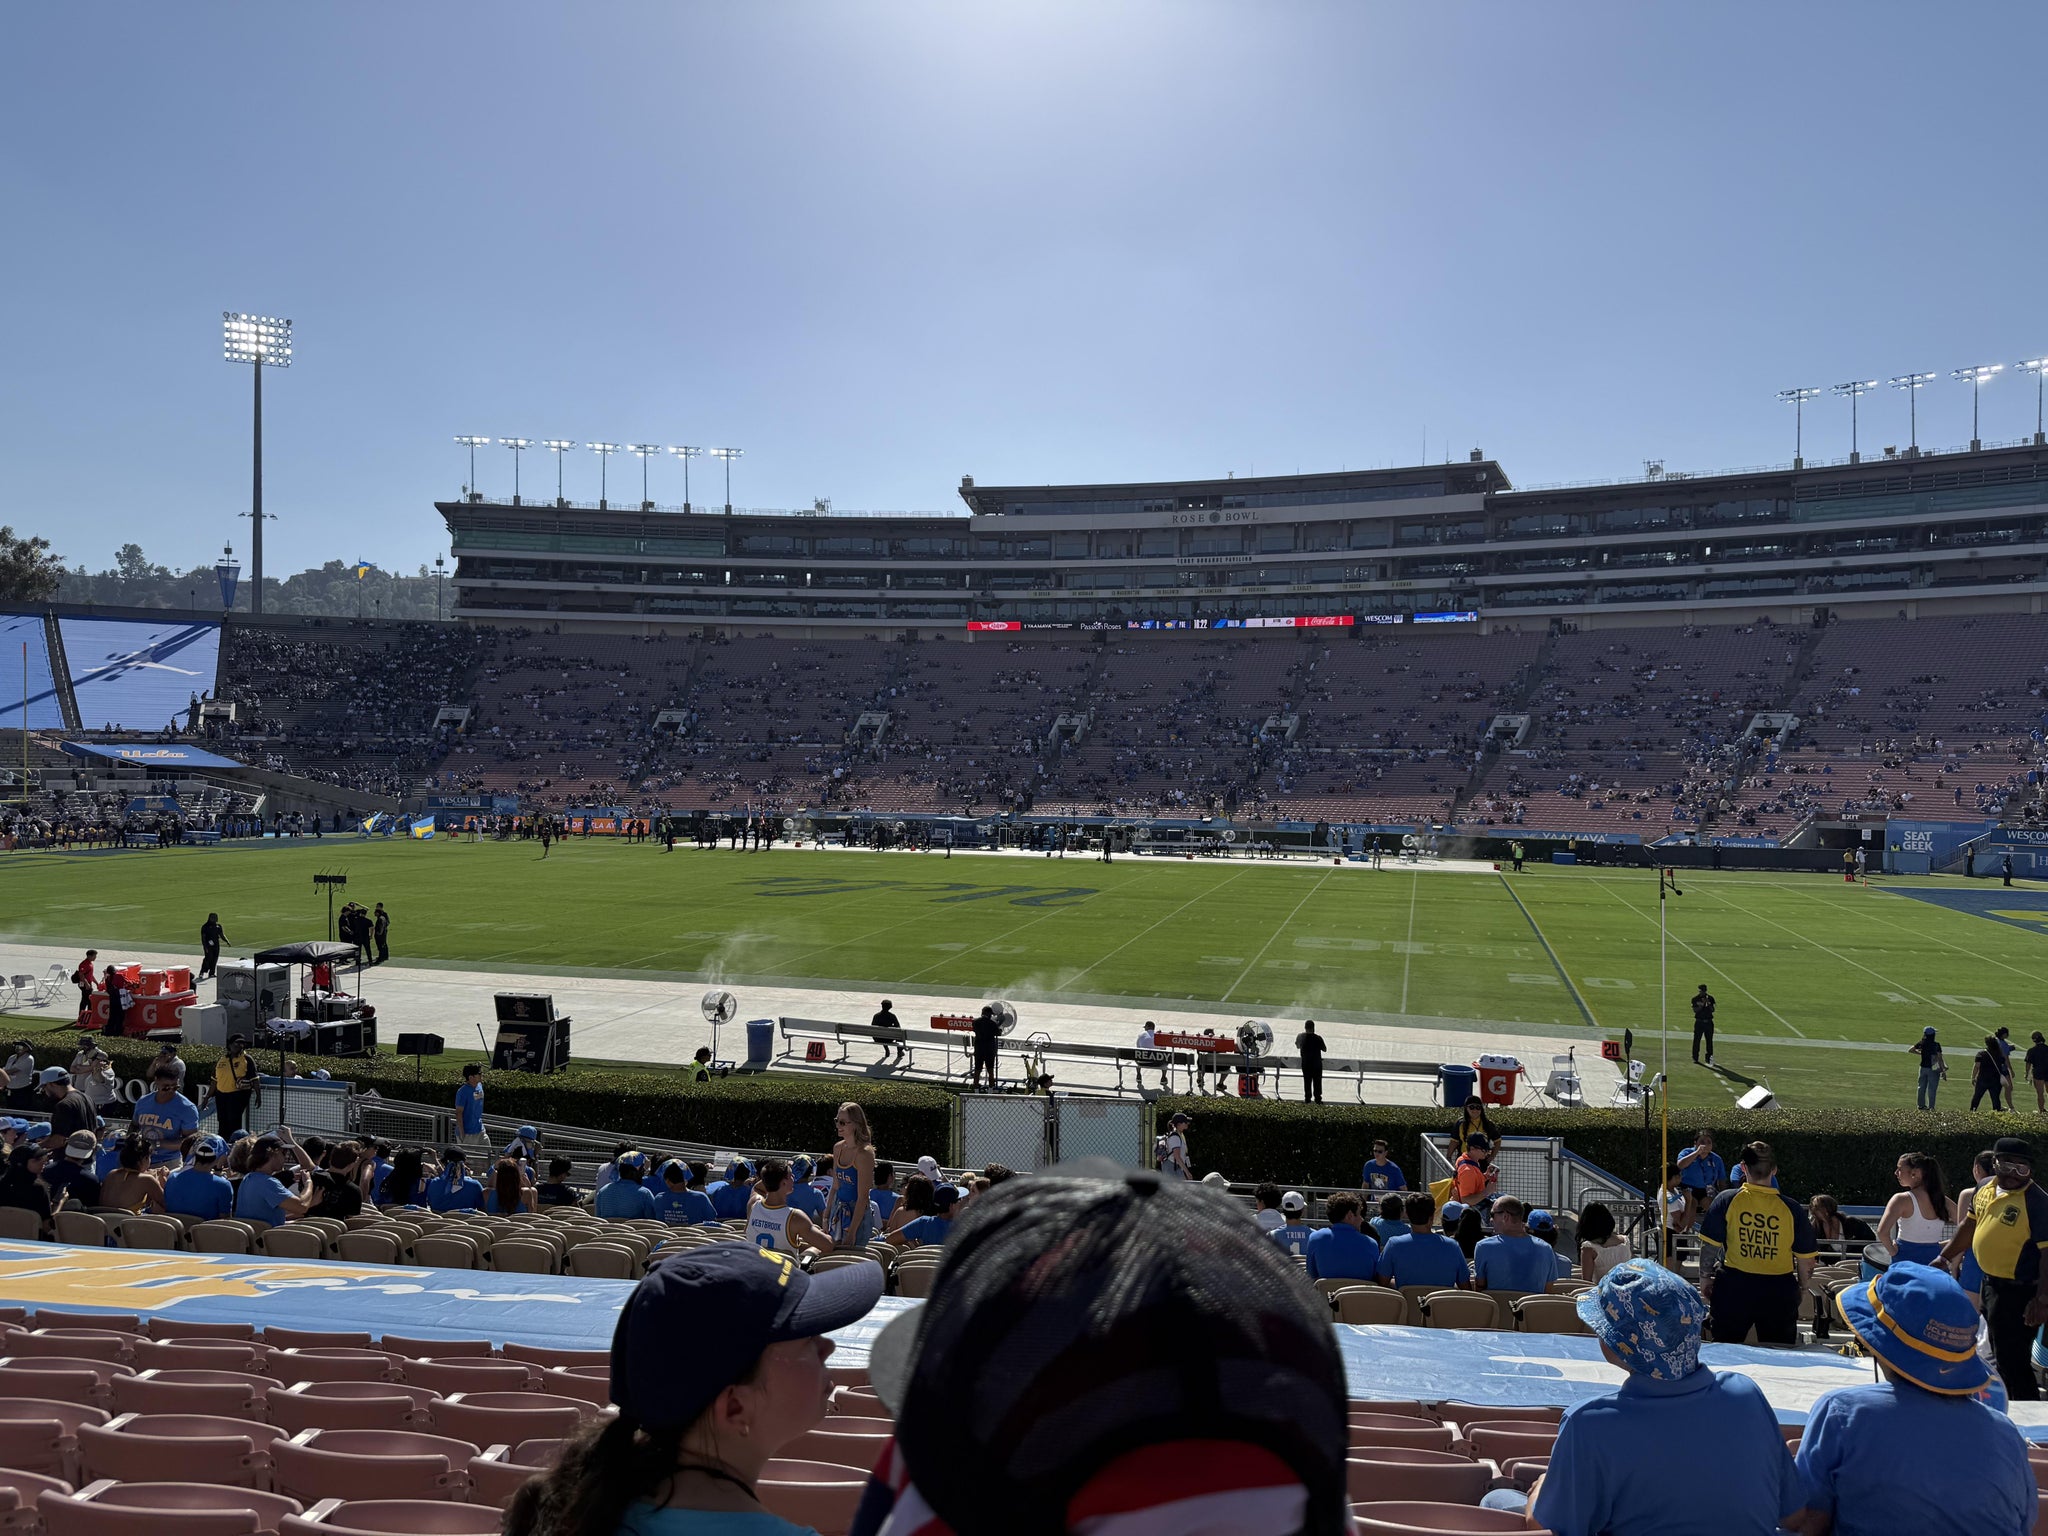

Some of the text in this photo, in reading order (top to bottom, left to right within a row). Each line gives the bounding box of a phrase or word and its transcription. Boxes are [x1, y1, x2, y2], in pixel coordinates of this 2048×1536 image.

[1172, 511, 1259, 524] ROSE BOWL
[1310, 617, 1336, 626] Coca-Cola
[1364, 615, 1393, 623] WESCOM
[1104, 622, 1122, 630] Roses
[438, 796, 469, 804] WESCOM
[1841, 813, 1860, 821] EXIT
[1903, 831, 1933, 841] SEAT
[1902, 841, 1934, 851] GEEK
[140, 976, 147, 985] G
[1505, 972, 1636, 990] 20
[78, 1012, 91, 1025] 40
[142, 1003, 158, 1024] G
[947, 1019, 973, 1028] GATOR
[1171, 1037, 1216, 1048] GATORADE
[807, 1042, 823, 1058] 40
[1134, 1050, 1171, 1062] READY
[1604, 1042, 1620, 1057] 20
[1487, 1076, 1507, 1096] G
[137, 1112, 174, 1130] UCLA
[1612, 1204, 1638, 1213] SEATS
[751, 1217, 782, 1232] WESTBROOK
[1739, 1211, 1780, 1230] CSC
[1738, 1227, 1779, 1247] EVENT
[1289, 1241, 1300, 1256] 1
[1740, 1243, 1779, 1261] STAFF
